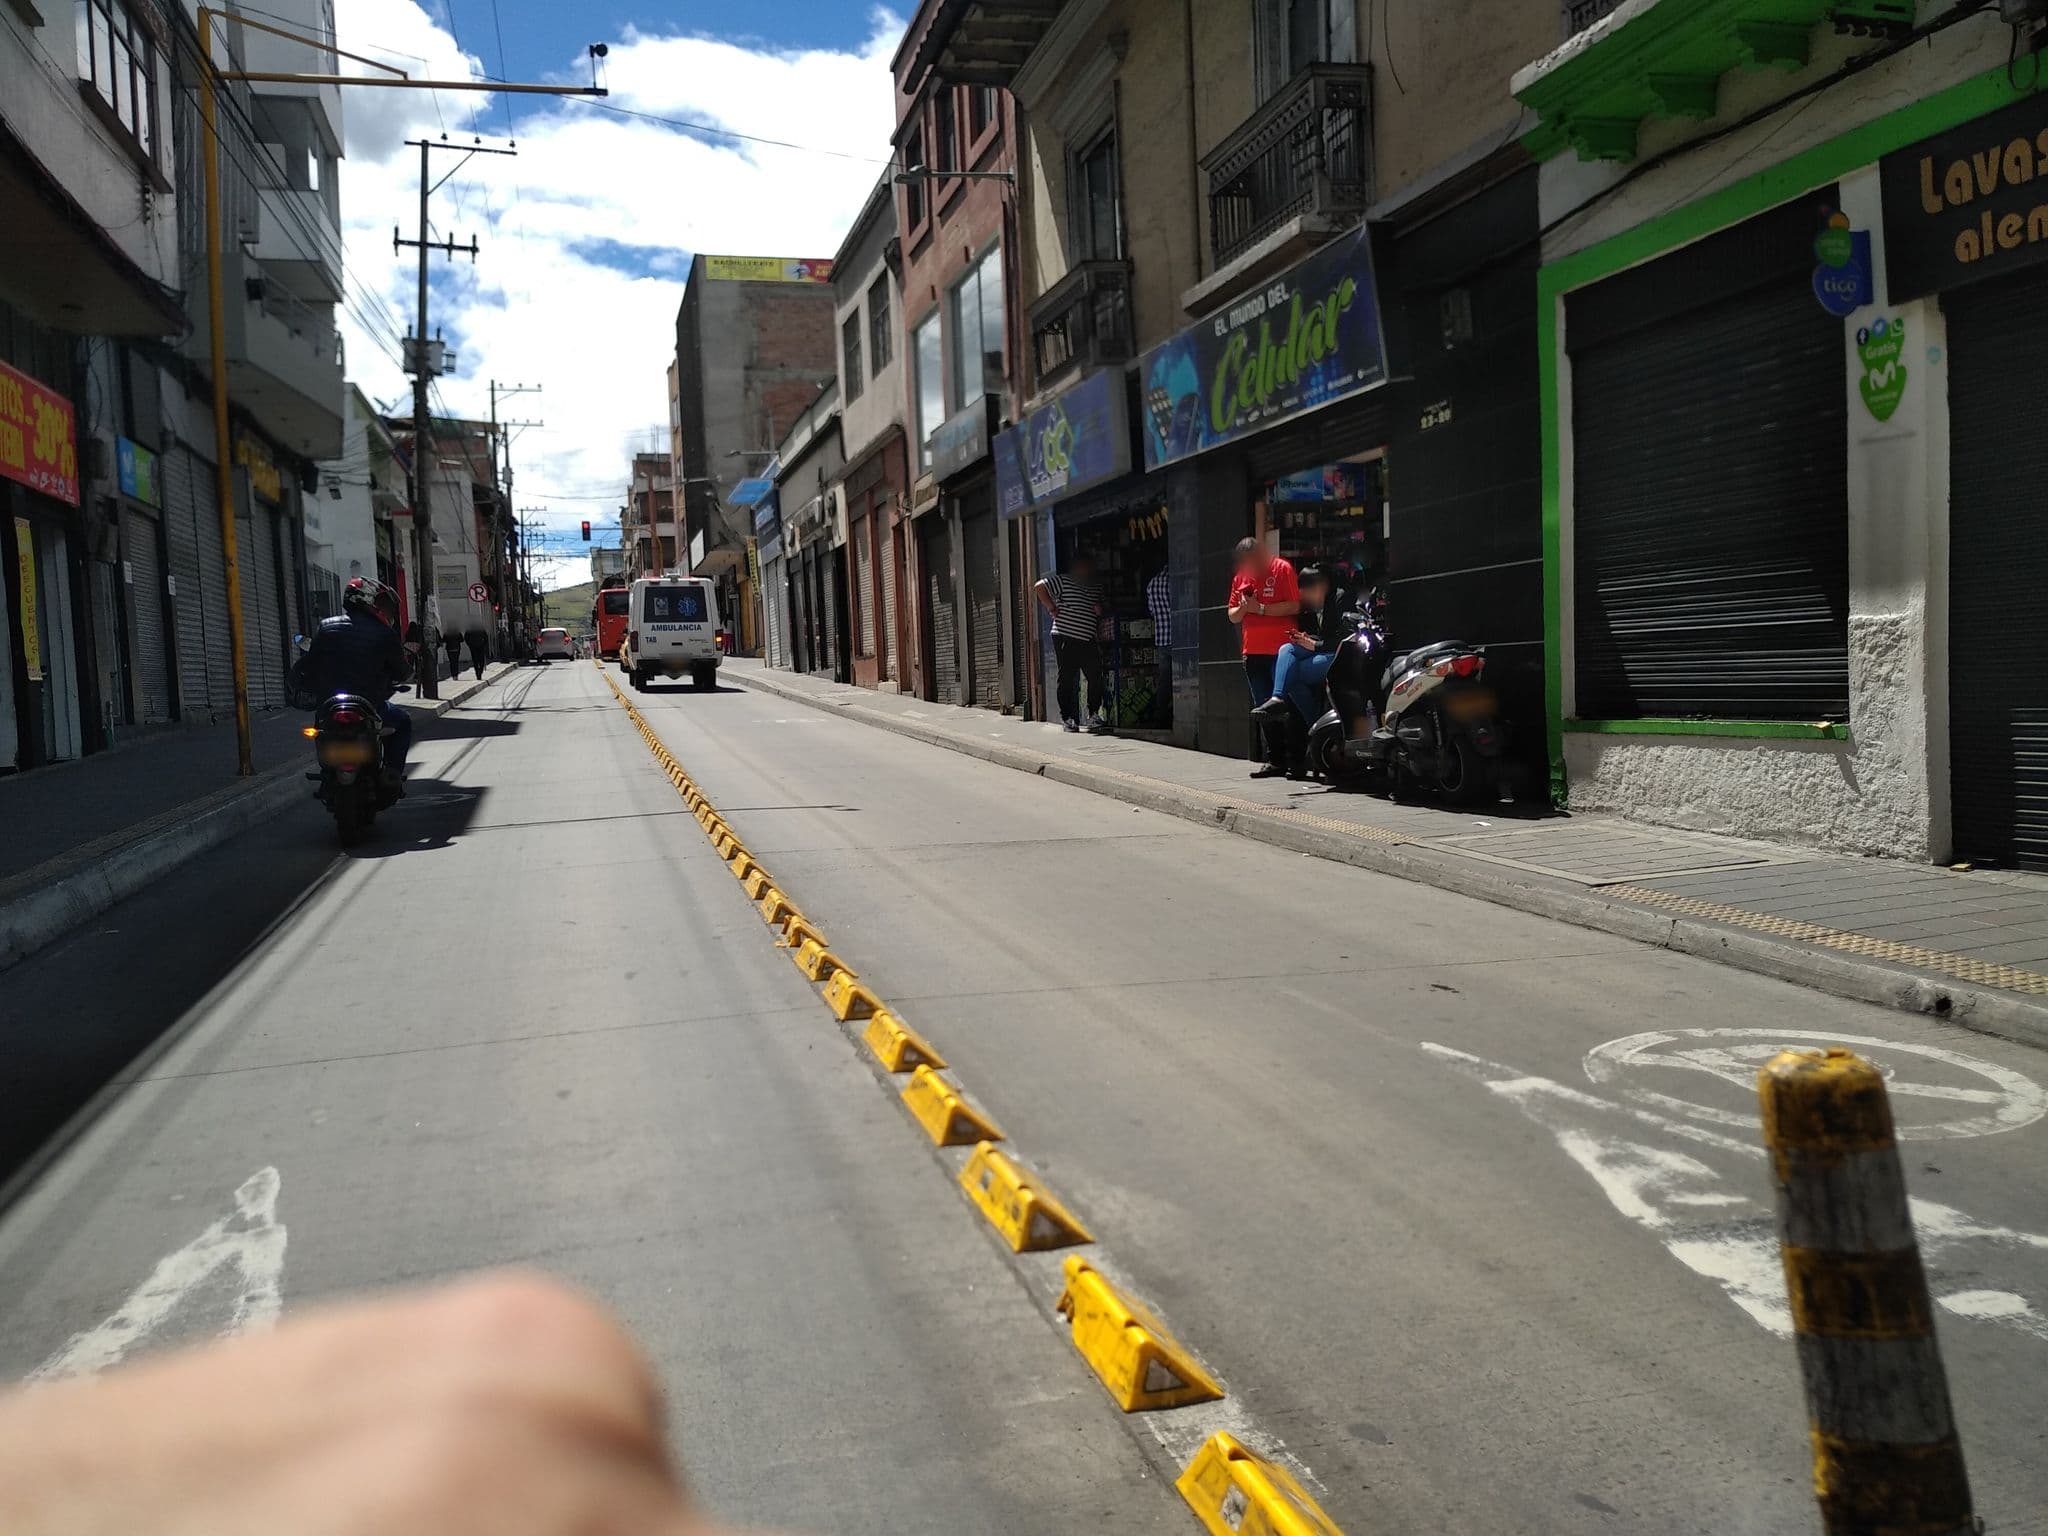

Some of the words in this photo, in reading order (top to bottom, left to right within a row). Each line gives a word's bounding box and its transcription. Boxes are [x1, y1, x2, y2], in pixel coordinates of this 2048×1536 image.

[1823, 276, 1857, 295] tigo
[1214, 317, 1229, 337] EL
[1229, 295, 1266, 330] MUNDO
[1267, 282, 1290, 310] DEL
[1211, 275, 1356, 433] Celular
[1866, 341, 1897, 360] Gratis
[651, 624, 702, 632] AMBULANCIA
